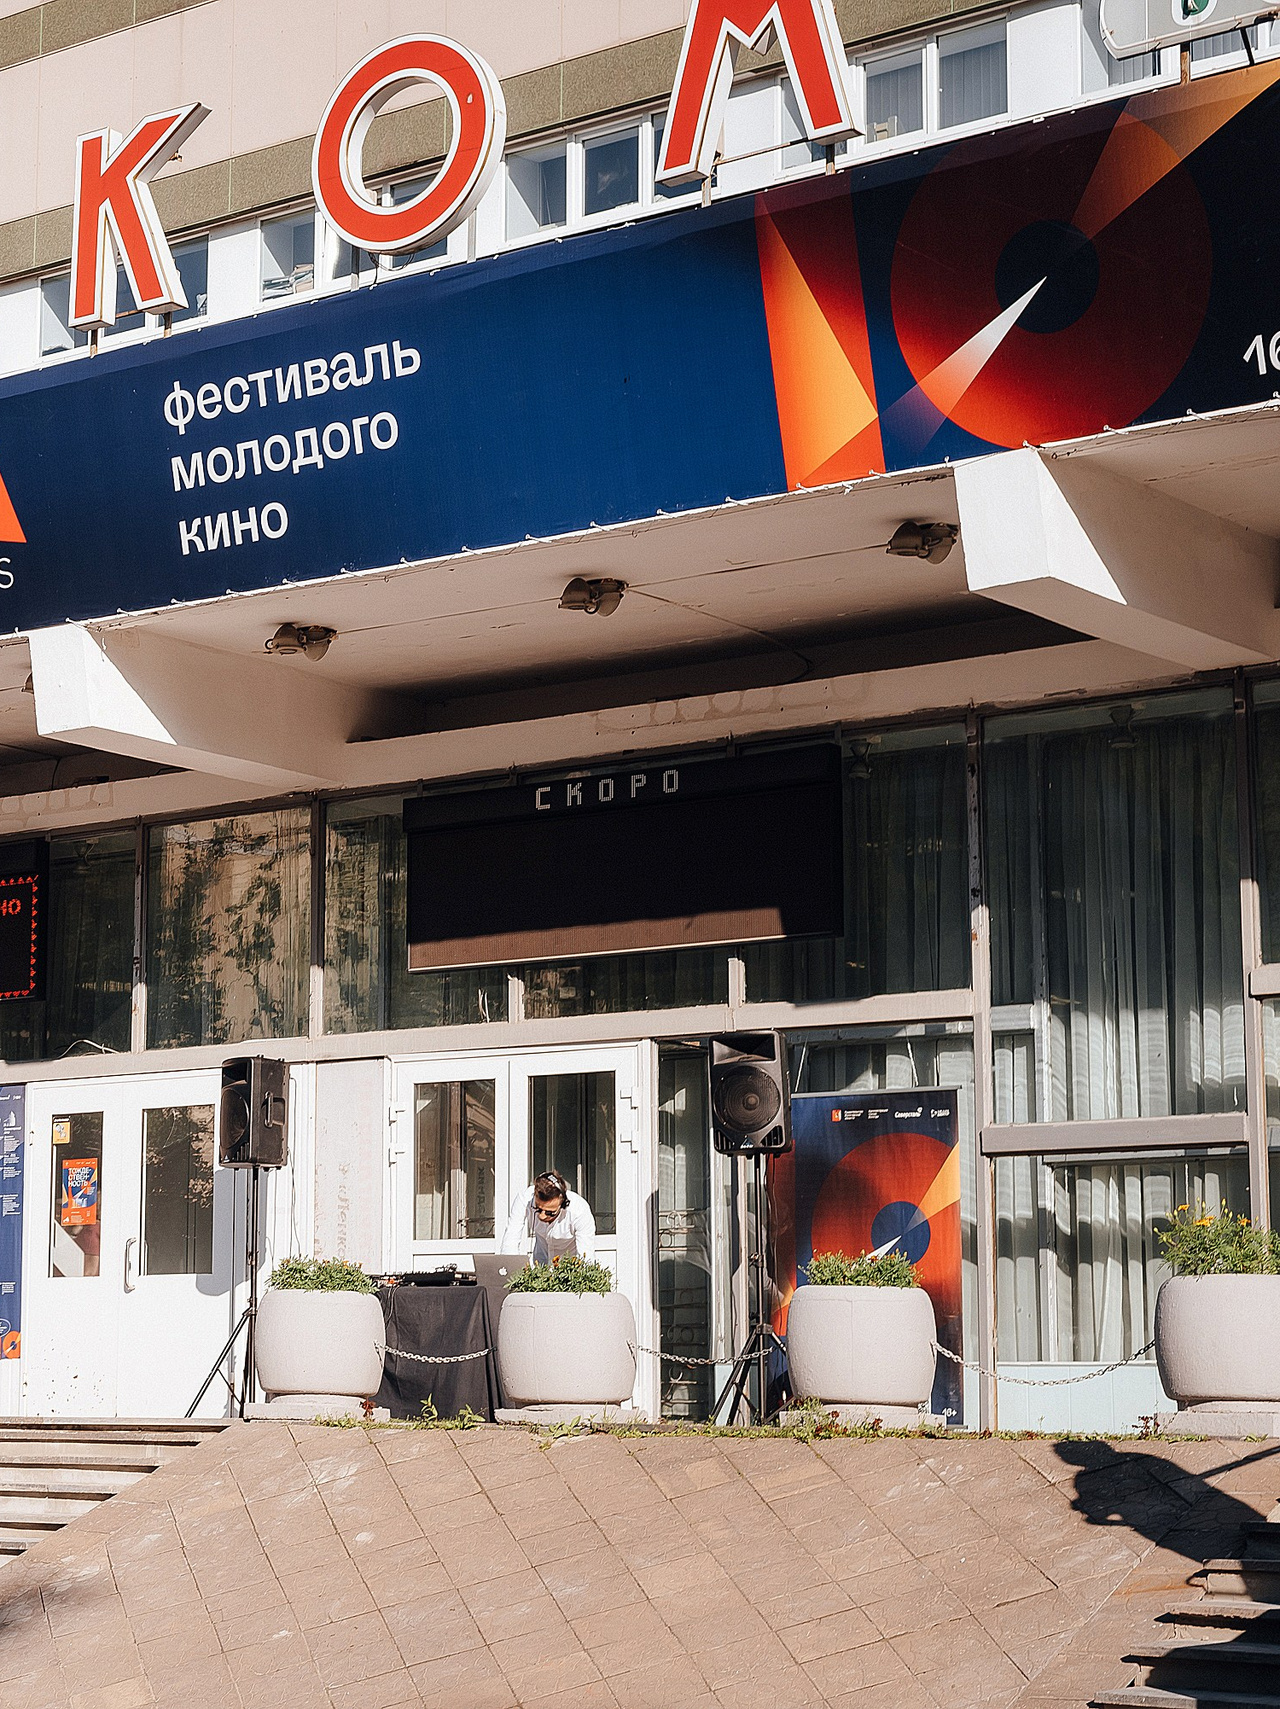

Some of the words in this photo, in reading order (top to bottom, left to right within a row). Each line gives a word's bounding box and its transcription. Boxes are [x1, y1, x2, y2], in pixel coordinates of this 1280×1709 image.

[162, 339, 422, 436] фестиваль
[170, 411, 400, 492] молодого
[178, 502, 289, 555] кино
[535, 769, 680, 811] СКОРО
